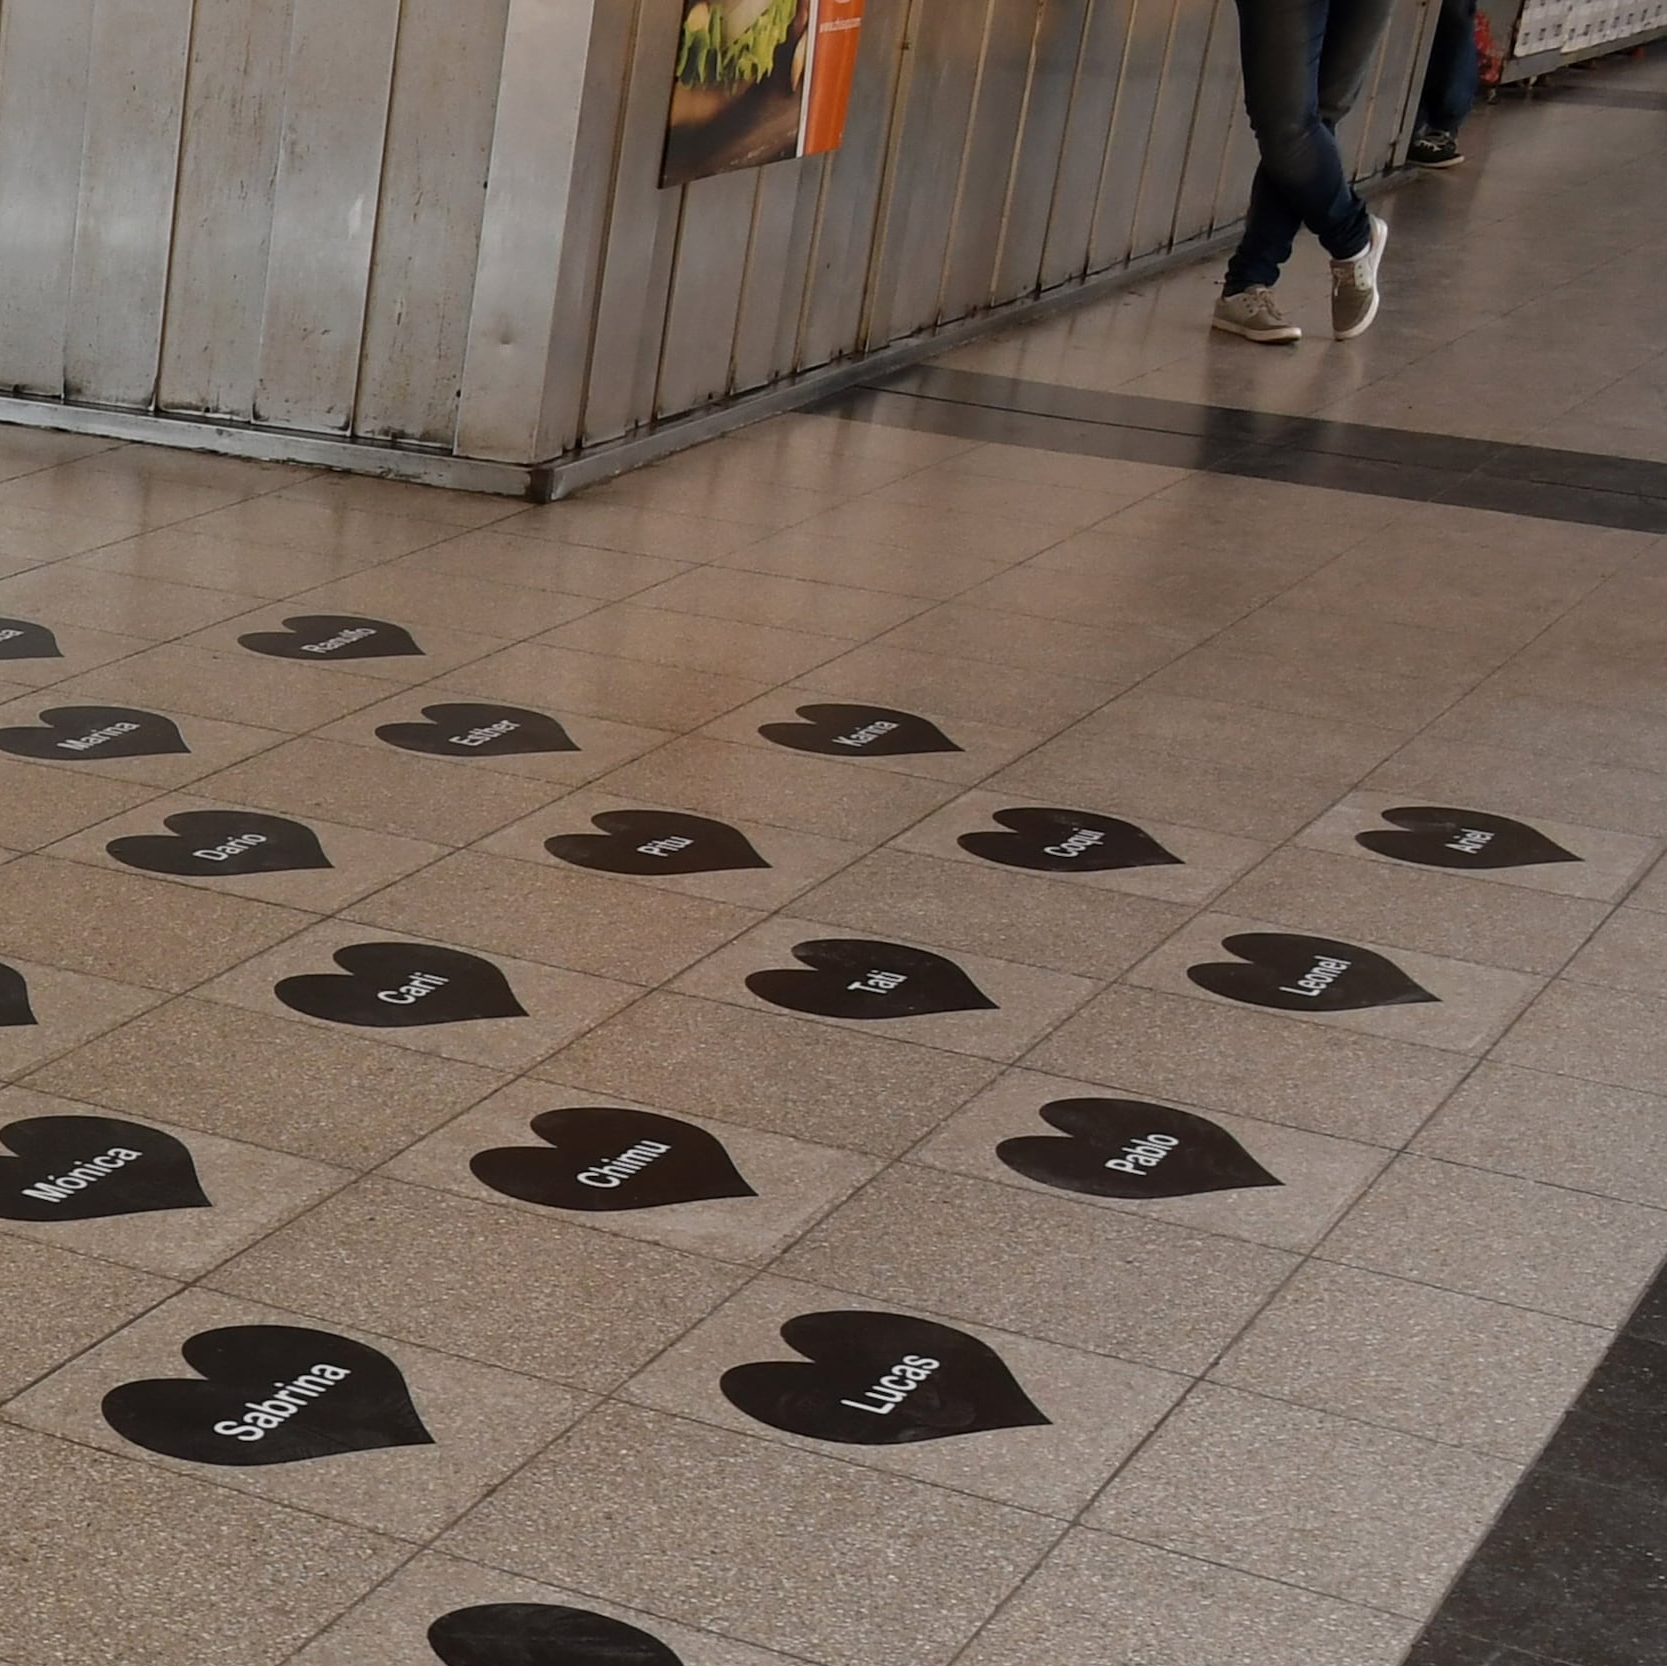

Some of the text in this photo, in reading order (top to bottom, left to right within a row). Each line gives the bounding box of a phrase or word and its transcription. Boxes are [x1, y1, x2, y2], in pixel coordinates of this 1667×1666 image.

[299, 627, 378, 655] Ranulfo
[56, 721, 141, 751] Marina
[448, 718, 521, 747] Esther
[831, 720, 899, 748] Karina
[636, 835, 694, 858] Pitu
[1042, 826, 1105, 858] Coqui
[1450, 826, 1496, 856] Ariel
[376, 971, 450, 1006] Carli
[846, 968, 908, 996] Tati
[1278, 954, 1352, 998] Leonel
[576, 1139, 672, 1189] Chimu
[1103, 1132, 1180, 1177] Pablo
[21, 1146, 144, 1204] Mónica
[840, 1354, 941, 1416] Lucas
[212, 1363, 352, 1442] Sabrina
